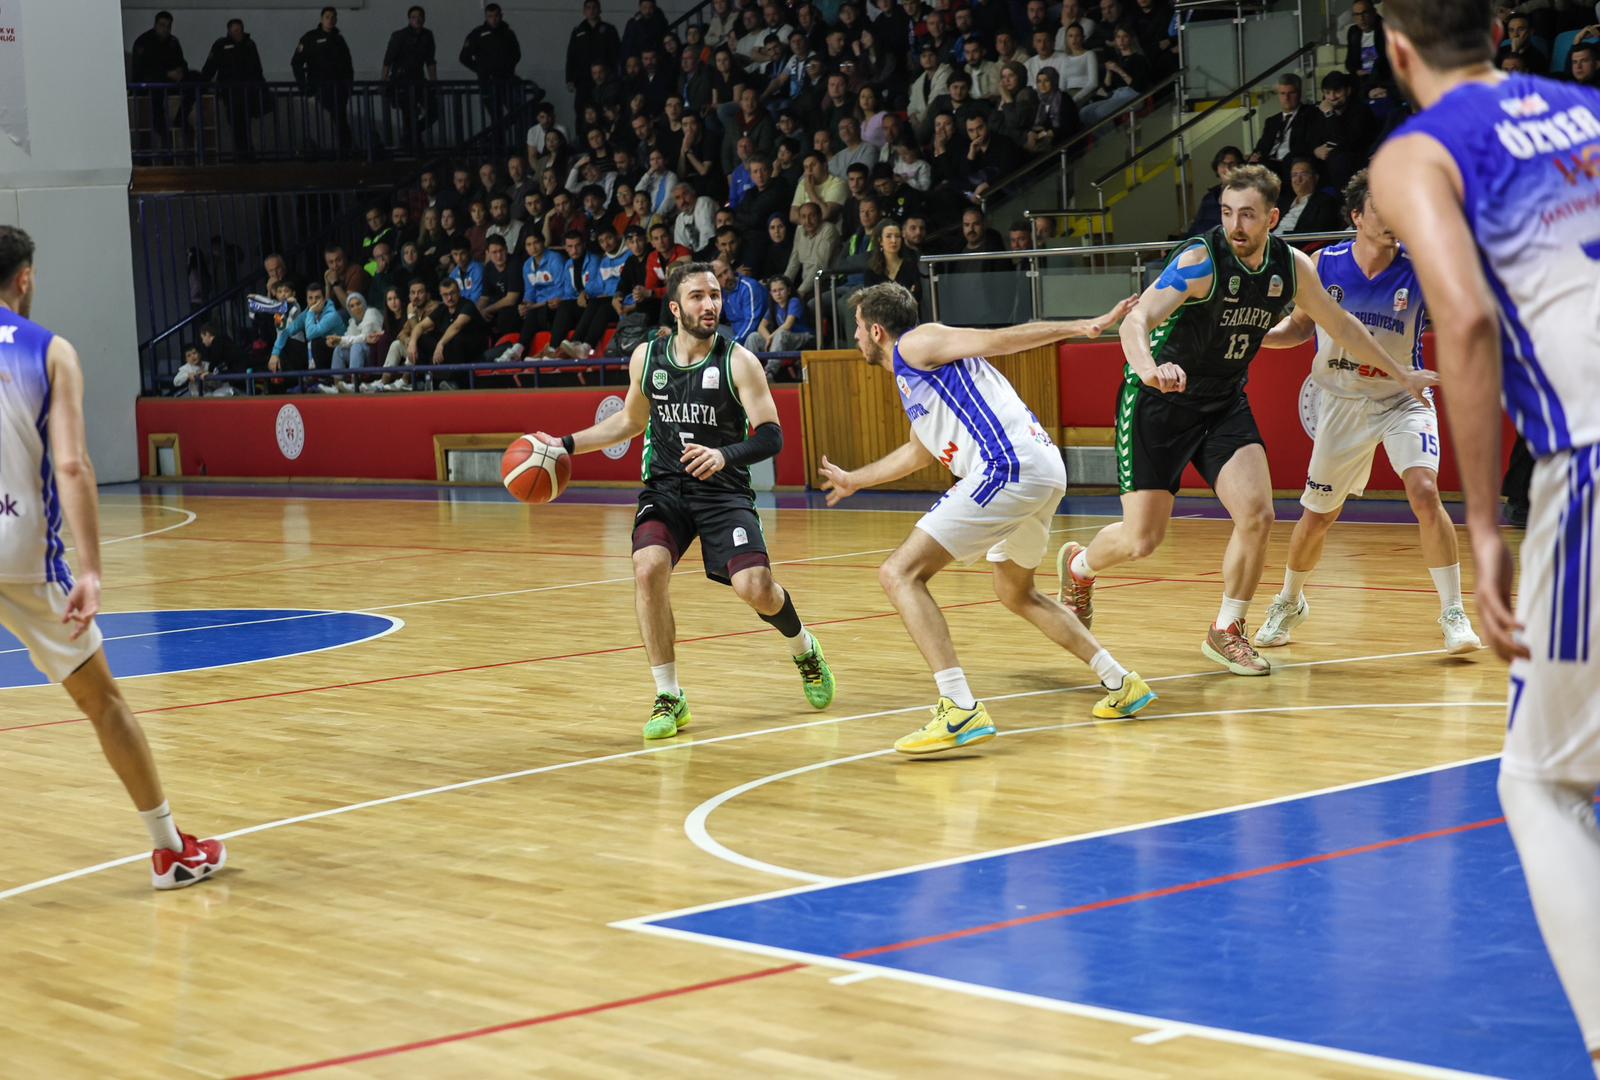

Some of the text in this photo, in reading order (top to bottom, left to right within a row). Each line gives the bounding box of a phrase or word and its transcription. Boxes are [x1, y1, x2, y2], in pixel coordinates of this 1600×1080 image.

[1219, 306, 1272, 330] SAKARYA
[1224, 333, 1250, 359] 13
[657, 403, 718, 427] SAKARYA
[1418, 432, 1438, 456] 15
[0, 493, 20, 517] k
